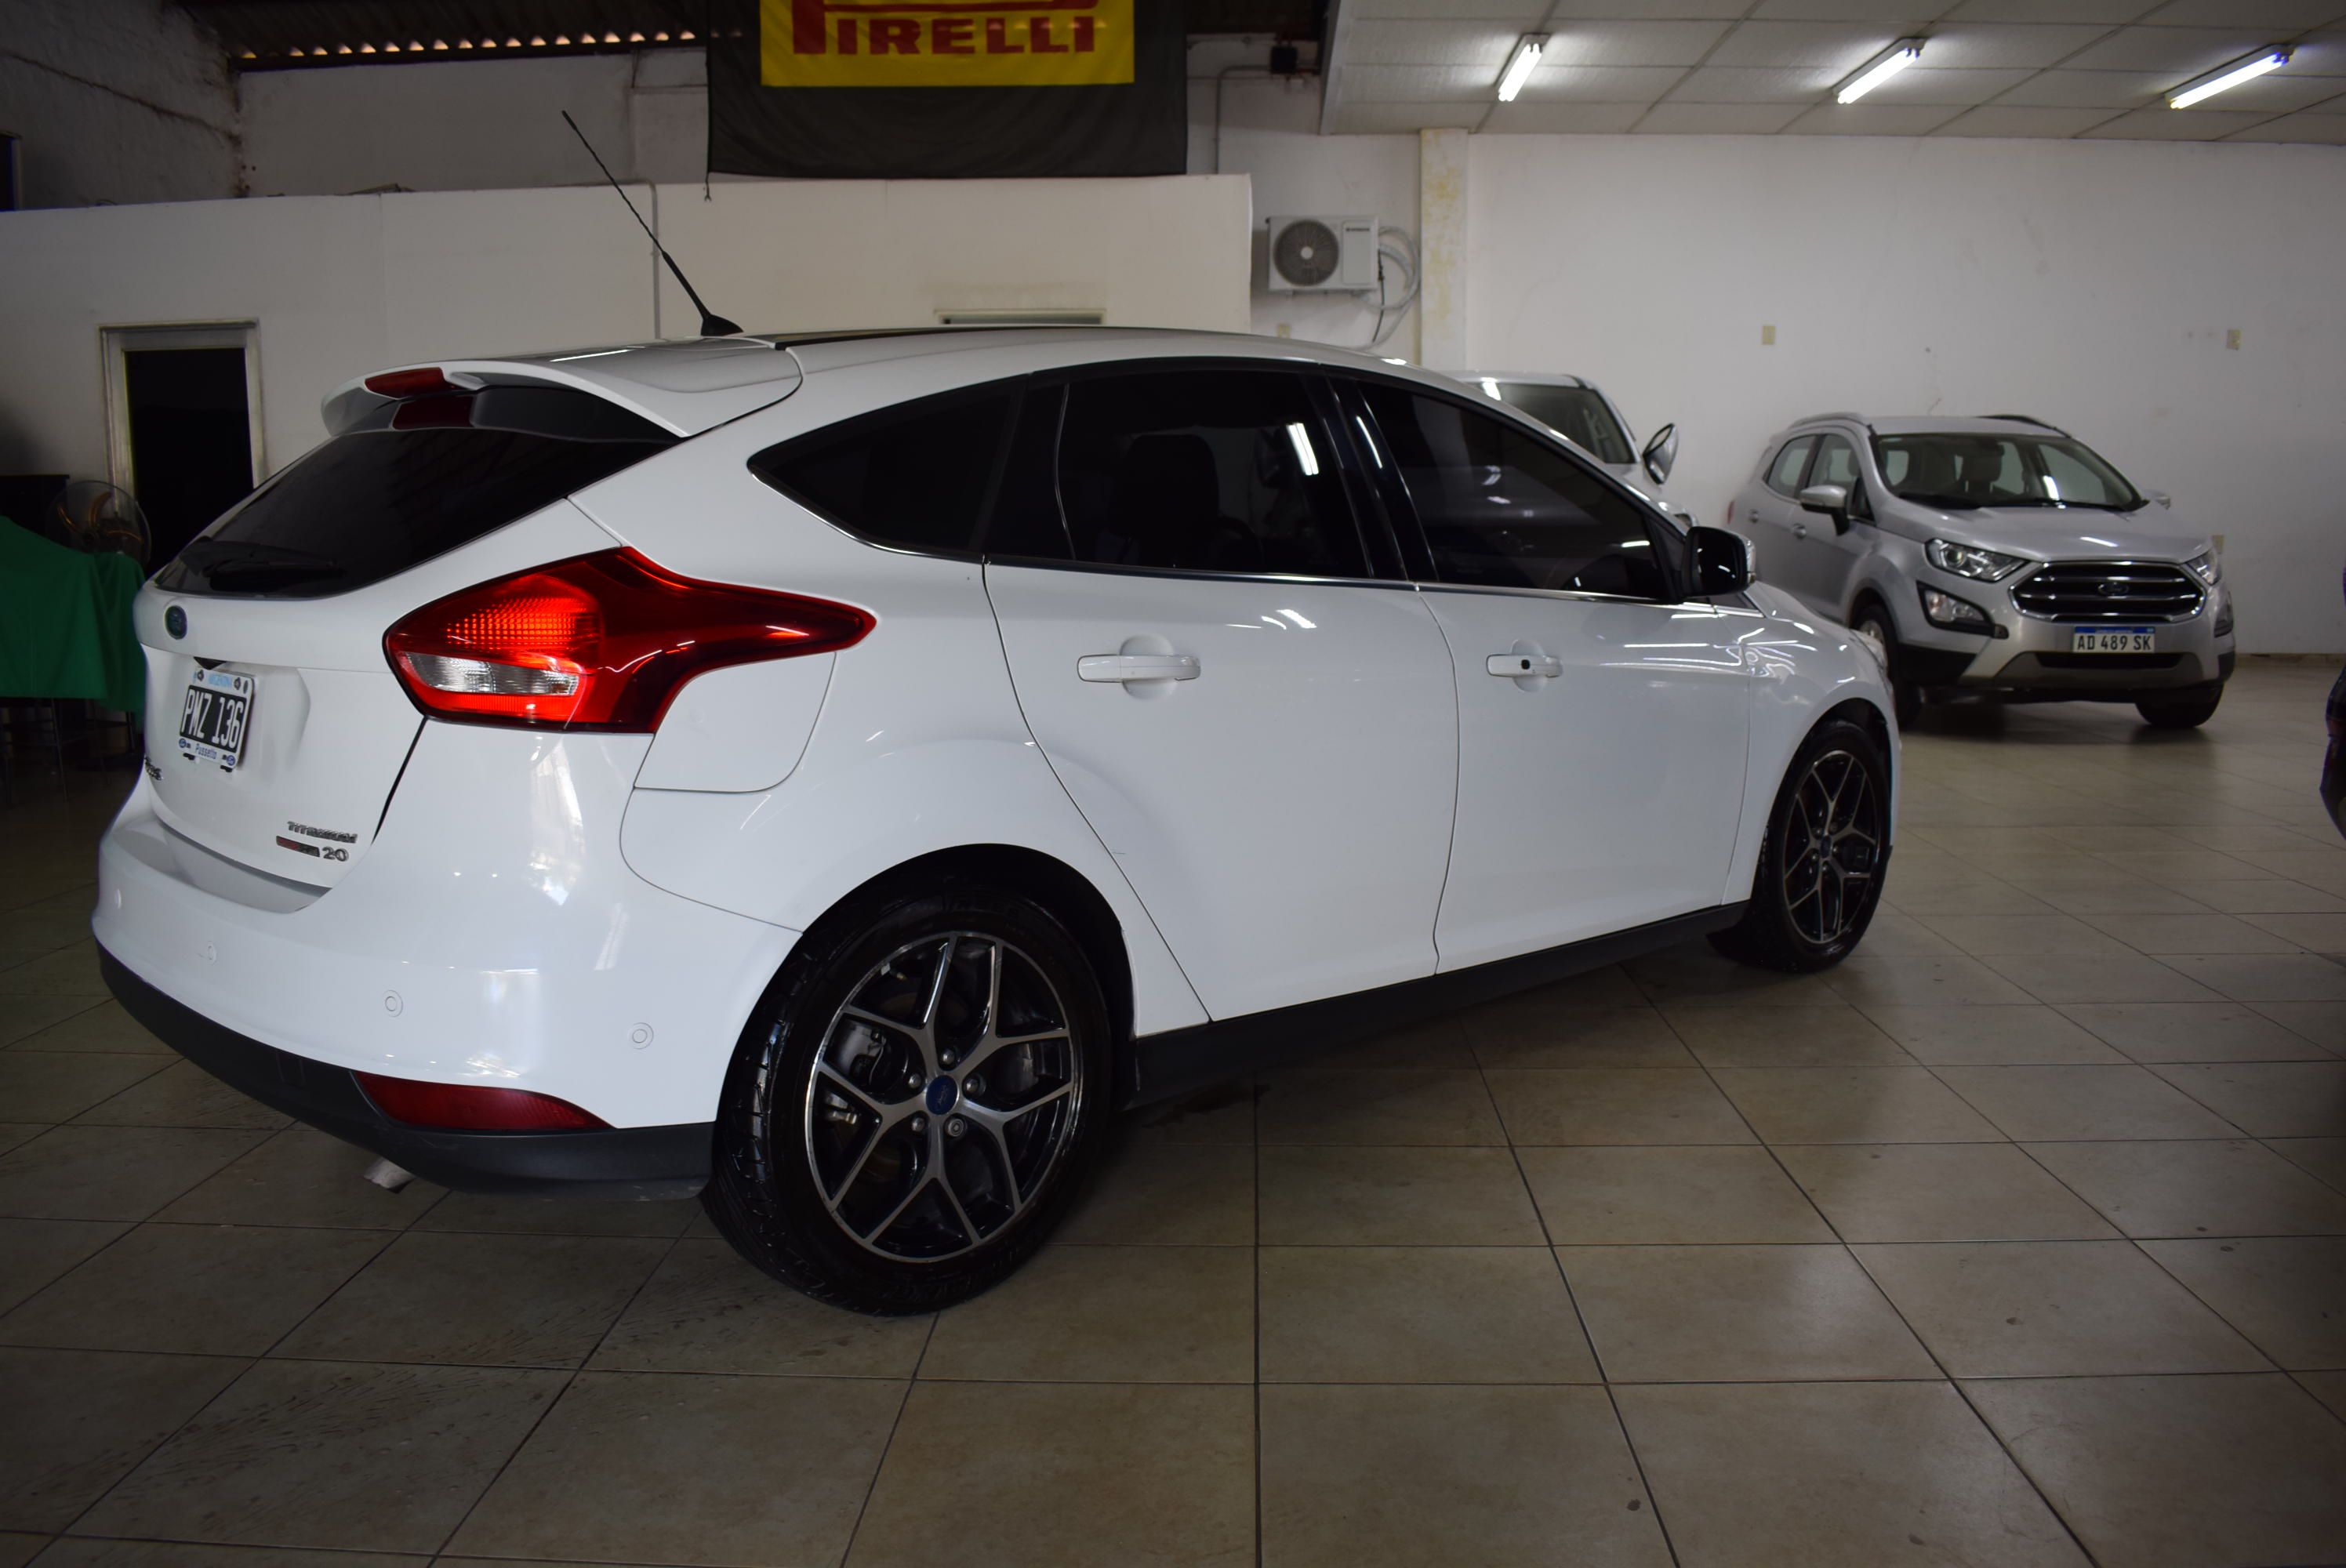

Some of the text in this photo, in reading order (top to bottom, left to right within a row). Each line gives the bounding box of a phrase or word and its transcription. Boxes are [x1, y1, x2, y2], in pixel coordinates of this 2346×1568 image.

[2077, 635, 2151, 650] AD 489 SK
[211, 696, 245, 749] 136
